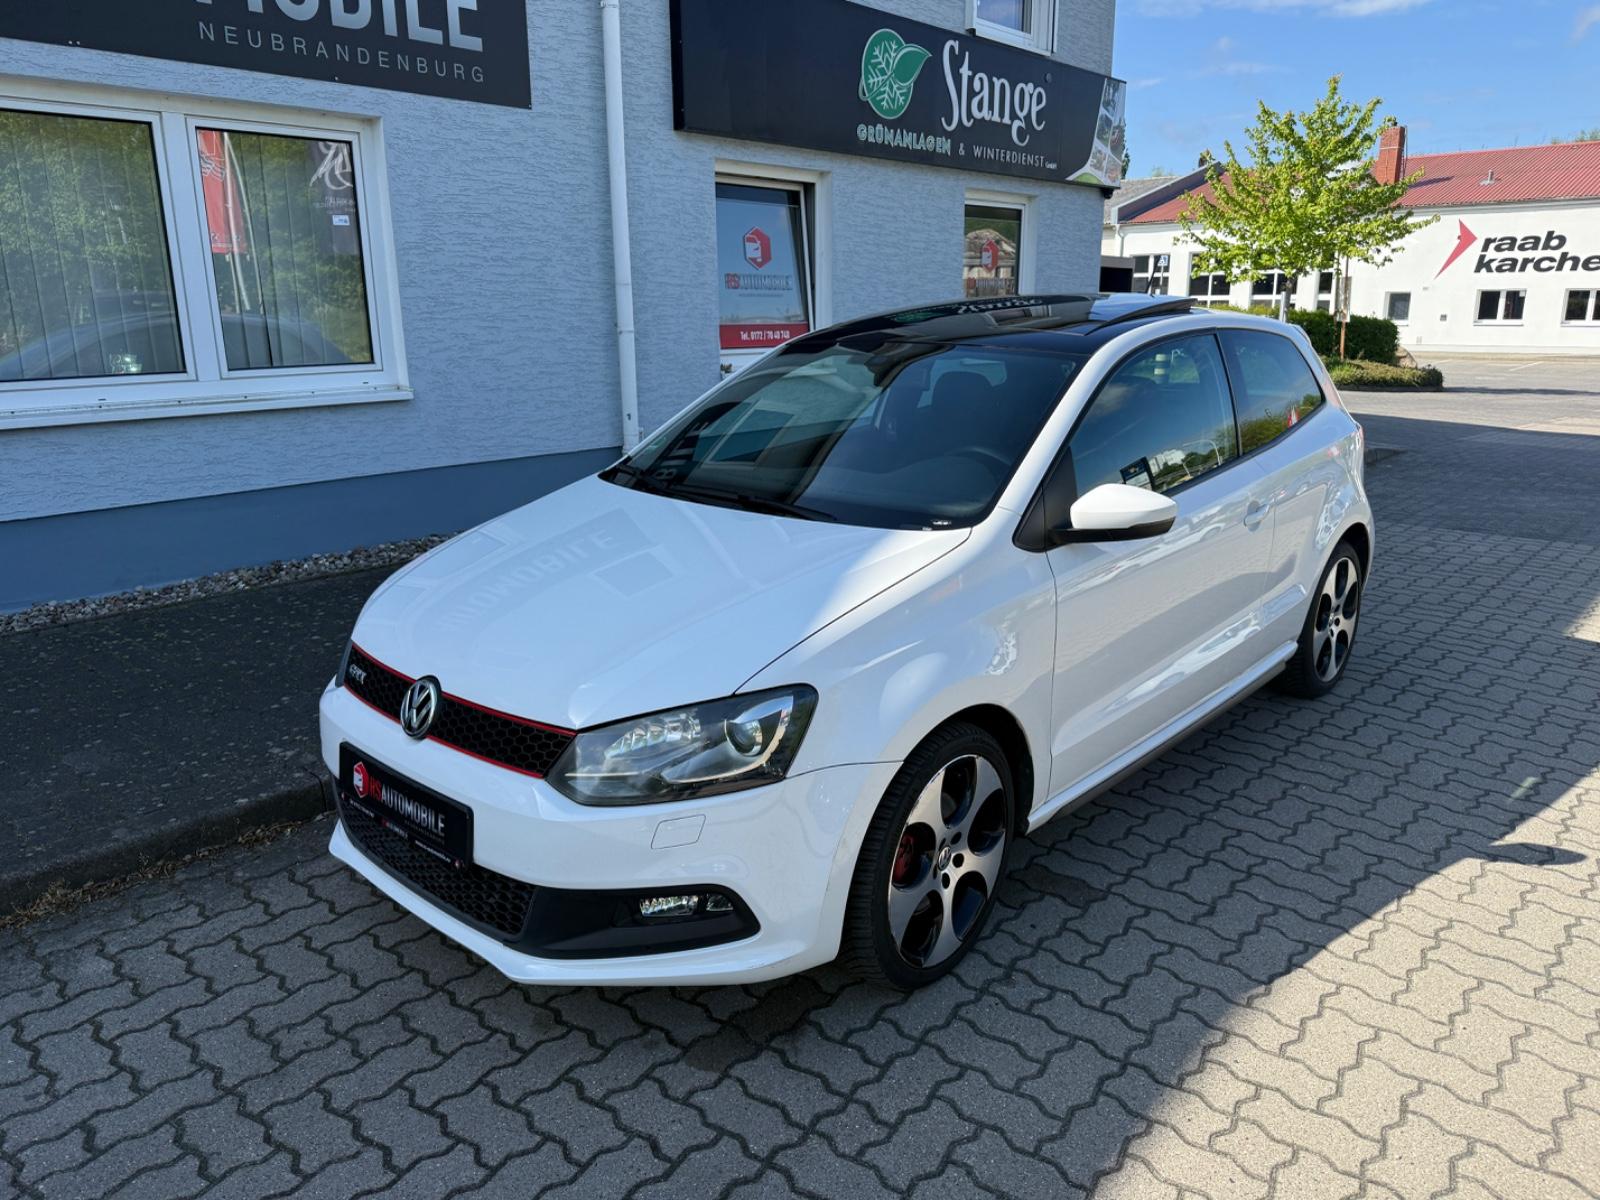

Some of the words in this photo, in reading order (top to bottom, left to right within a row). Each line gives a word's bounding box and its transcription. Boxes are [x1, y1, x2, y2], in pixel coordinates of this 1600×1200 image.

[199, 21, 485, 83] NEUBRANDENBURG
[941, 39, 1047, 147] Stange
[856, 123, 952, 156] GRÜNANLAGEN
[958, 142, 966, 156] &
[973, 145, 1045, 168] WINTERDIENST
[1481, 230, 1567, 253] raab
